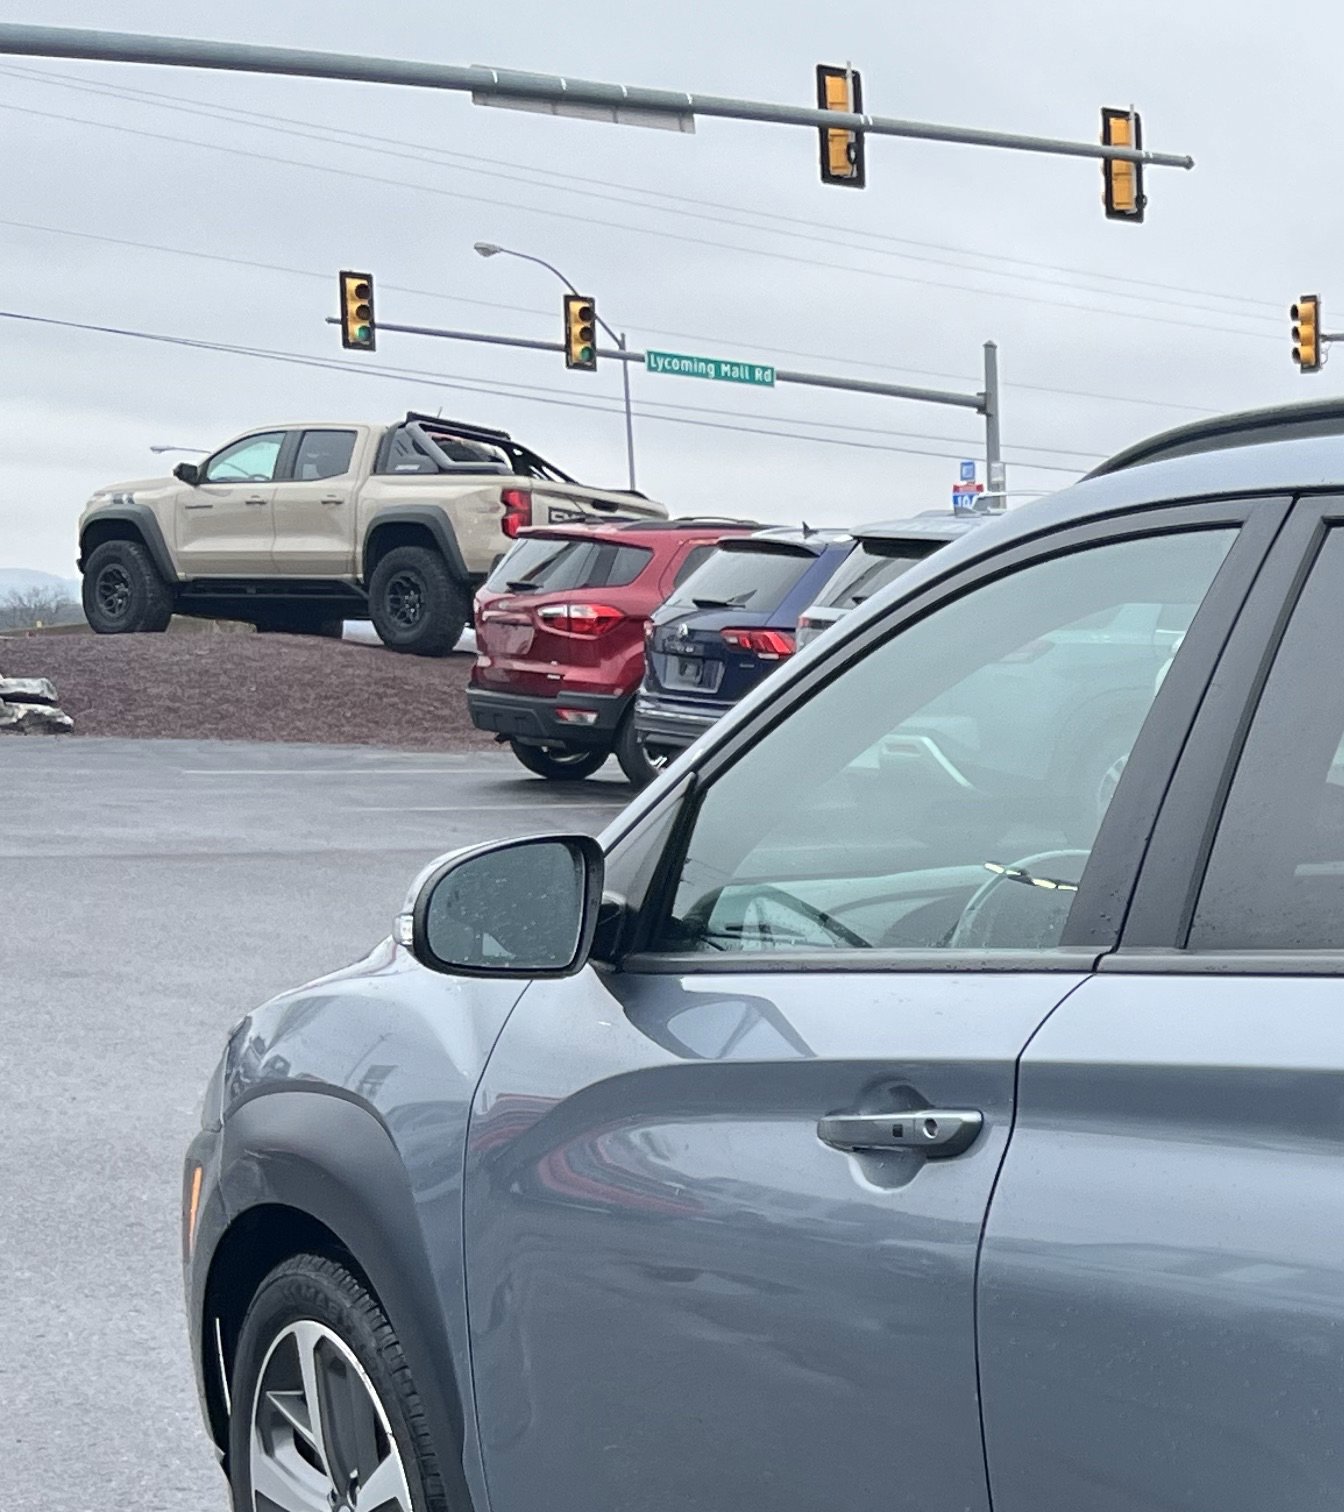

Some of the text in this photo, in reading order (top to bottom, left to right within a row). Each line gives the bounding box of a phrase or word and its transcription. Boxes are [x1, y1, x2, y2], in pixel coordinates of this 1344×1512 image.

[650, 353, 772, 383] Lycoming Mall Rd
